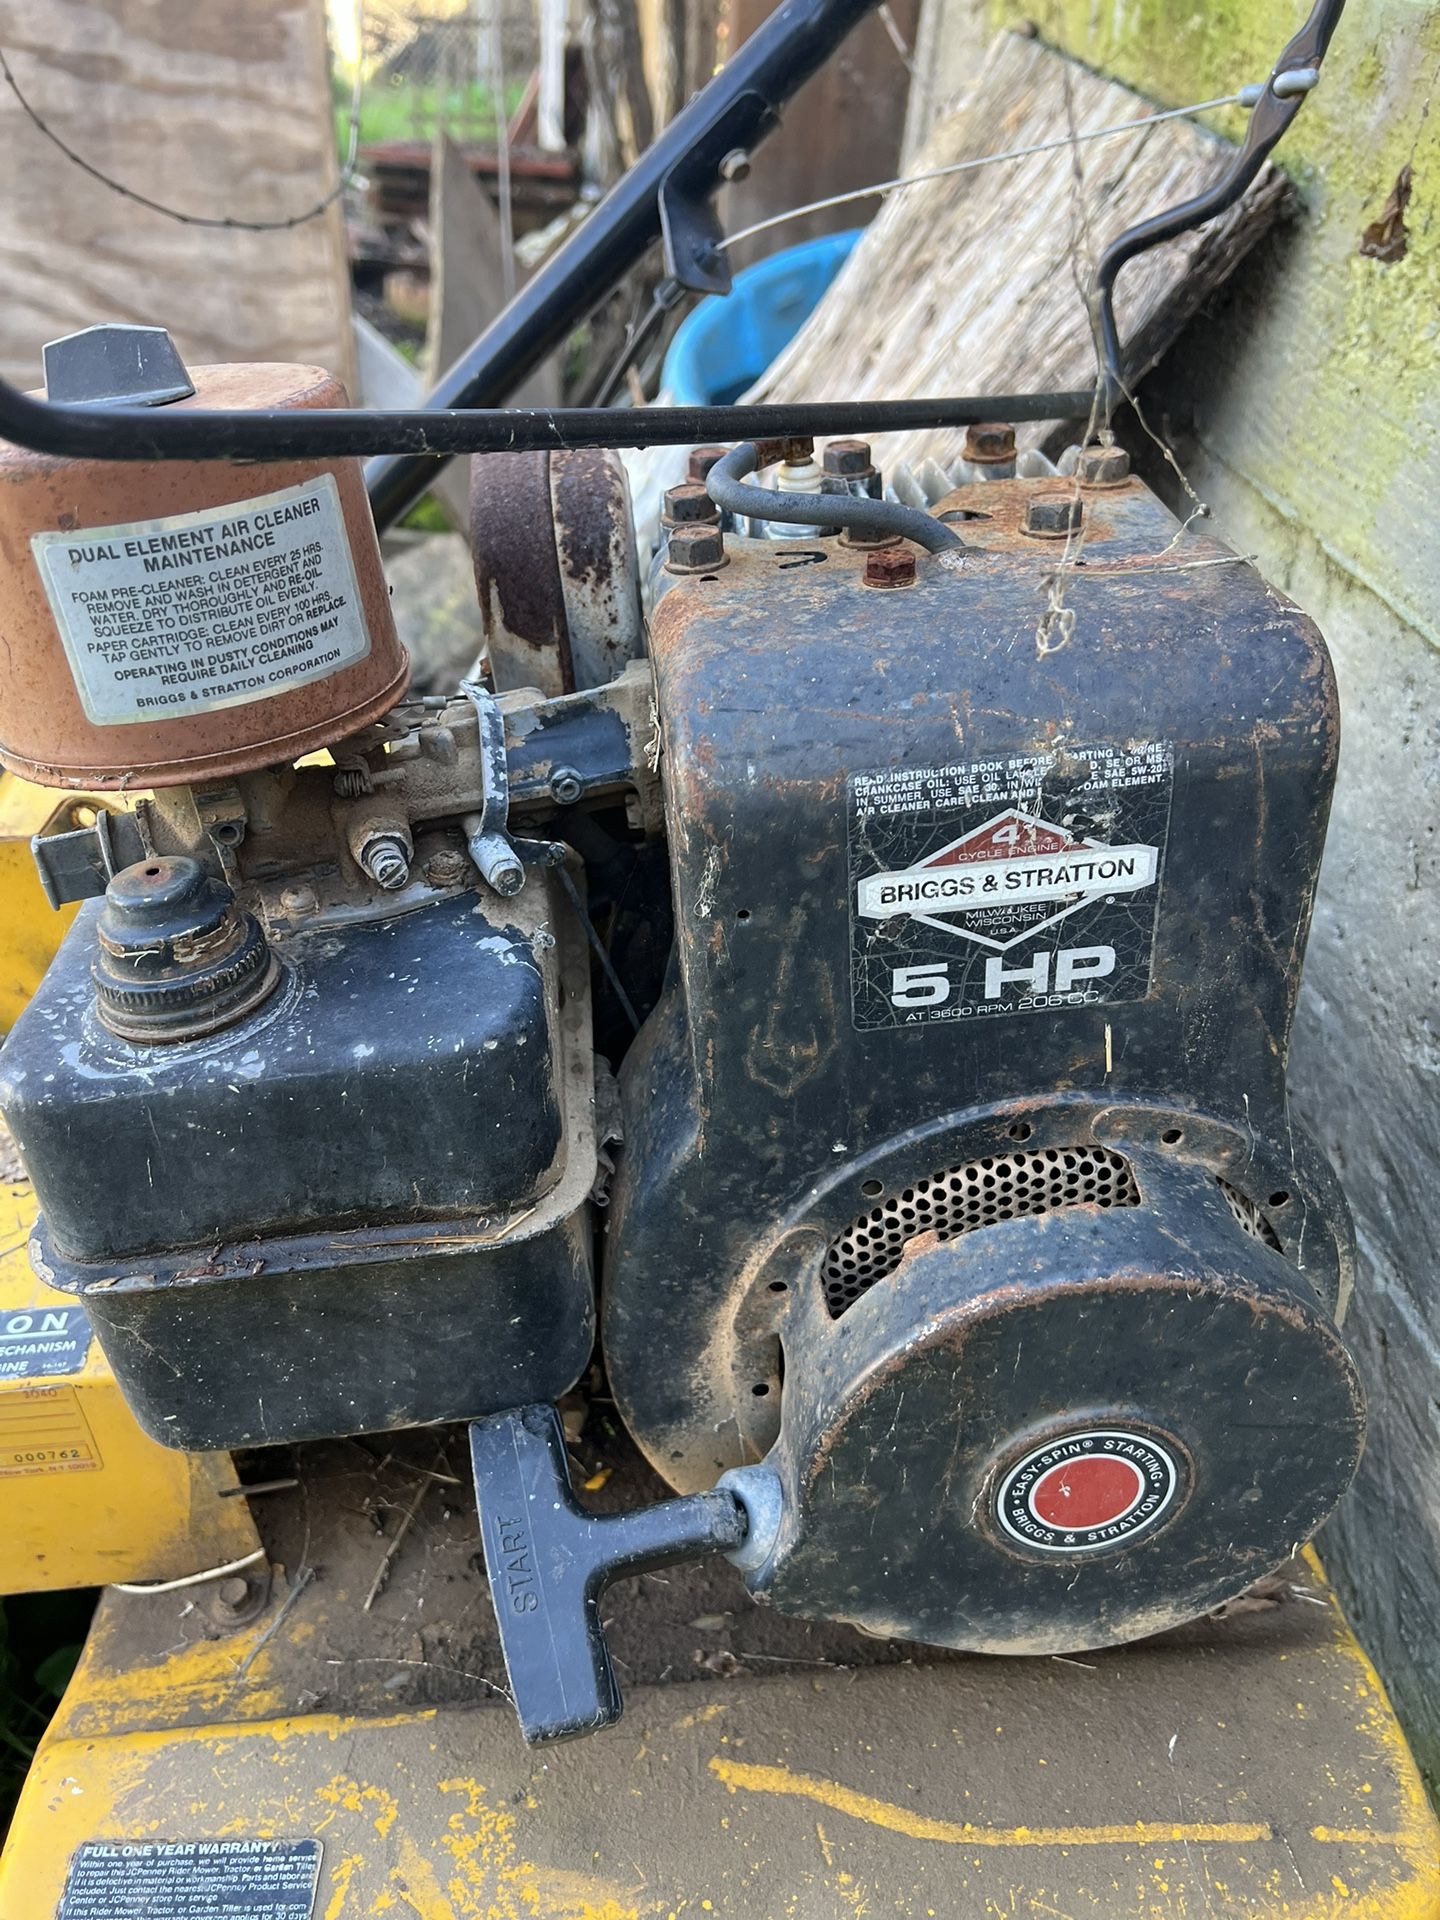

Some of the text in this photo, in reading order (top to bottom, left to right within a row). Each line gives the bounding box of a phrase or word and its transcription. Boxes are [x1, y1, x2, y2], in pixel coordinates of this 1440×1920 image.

[68, 498, 320, 563] DUAL ELEMENT AIR CLEANER
[143, 531, 276, 573] MAINTENANCE
[71, 541, 324, 604] FOAM PRE-CLEANER: CLEAN EVERY 25 HRS.
[87, 554, 322, 615] REMOVE AND WASH IN DETERGENT AND
[89, 567, 323, 627] WATER. DRY THOROUGHLY AND RE-OIL
[94, 581, 319, 638] SQUEEZE TO DISTRIBUTE OIL EVENLY.
[87, 590, 333, 654] PAPER CARTRIDGE: CLEAN EVERY 100 HRS.
[102, 595, 347, 664] TAP GENTLY TO REMOVE DIRT OR REPLACE
[114, 616, 340, 681] OPERATING IN DUSTY CONDITIONS MAY
[161, 639, 314, 686] REQUIRE DAILY CLEANING
[136, 648, 341, 708] BRIGGS & STRATTON CORPORATION
[855, 781, 923, 798] CRANKCASE
[926, 779, 950, 790] OIL:
[954, 774, 977, 786] USE
[981, 771, 1001, 783] OIL
[1106, 757, 1121, 769] SE
[1125, 755, 1141, 767] OR
[856, 797, 869, 808] IN
[874, 790, 925, 806] SUMMER,
[930, 787, 953, 799] USE
[958, 784, 980, 796] SAE
[985, 781, 1001, 792] 30.
[1007, 779, 1019, 790] IN
[1104, 767, 1126, 779] SAE
[890, 765, 966, 783] INSTRUCTION
[971, 761, 1003, 774] BOOK
[1009, 755, 1054, 770] BEFORE
[880, 799, 931, 815] CLEANER
[935, 796, 965, 808] CARE
[972, 791, 1008, 804] CLEAN
[1011, 787, 1035, 799] AND
[1077, 780, 1109, 792] OAM
[1111, 773, 1166, 788] ELEMENT.
[958, 842, 1059, 862] CYCLE ENGINE
[992, 824, 1021, 846] 4
[880, 857, 1135, 905] BRIGGS & STRATTON
[965, 903, 1046, 920] MILWAUKEE
[965, 911, 1047, 928] WISCONSIN
[891, 945, 1116, 1008] 5 HP
[905, 989, 1100, 1022] AT 3600 RPM 206 CC
[14, 1449, 80, 1463] 000762
[1104, 1439, 1163, 1482] STARTING
[1012, 1493, 1160, 1544] BRIGGS & STRATTON
[497, 1515, 539, 1613] START
[80, 1859, 105, 1868] Within
[229, 1855, 260, 1866] provide
[82, 1846, 119, 1858] FULL
[122, 1845, 154, 1857] ONE
[156, 1843, 196, 1856] YEAR
[110, 1868, 125, 1877] this
[159, 1885, 173, 1893] the
